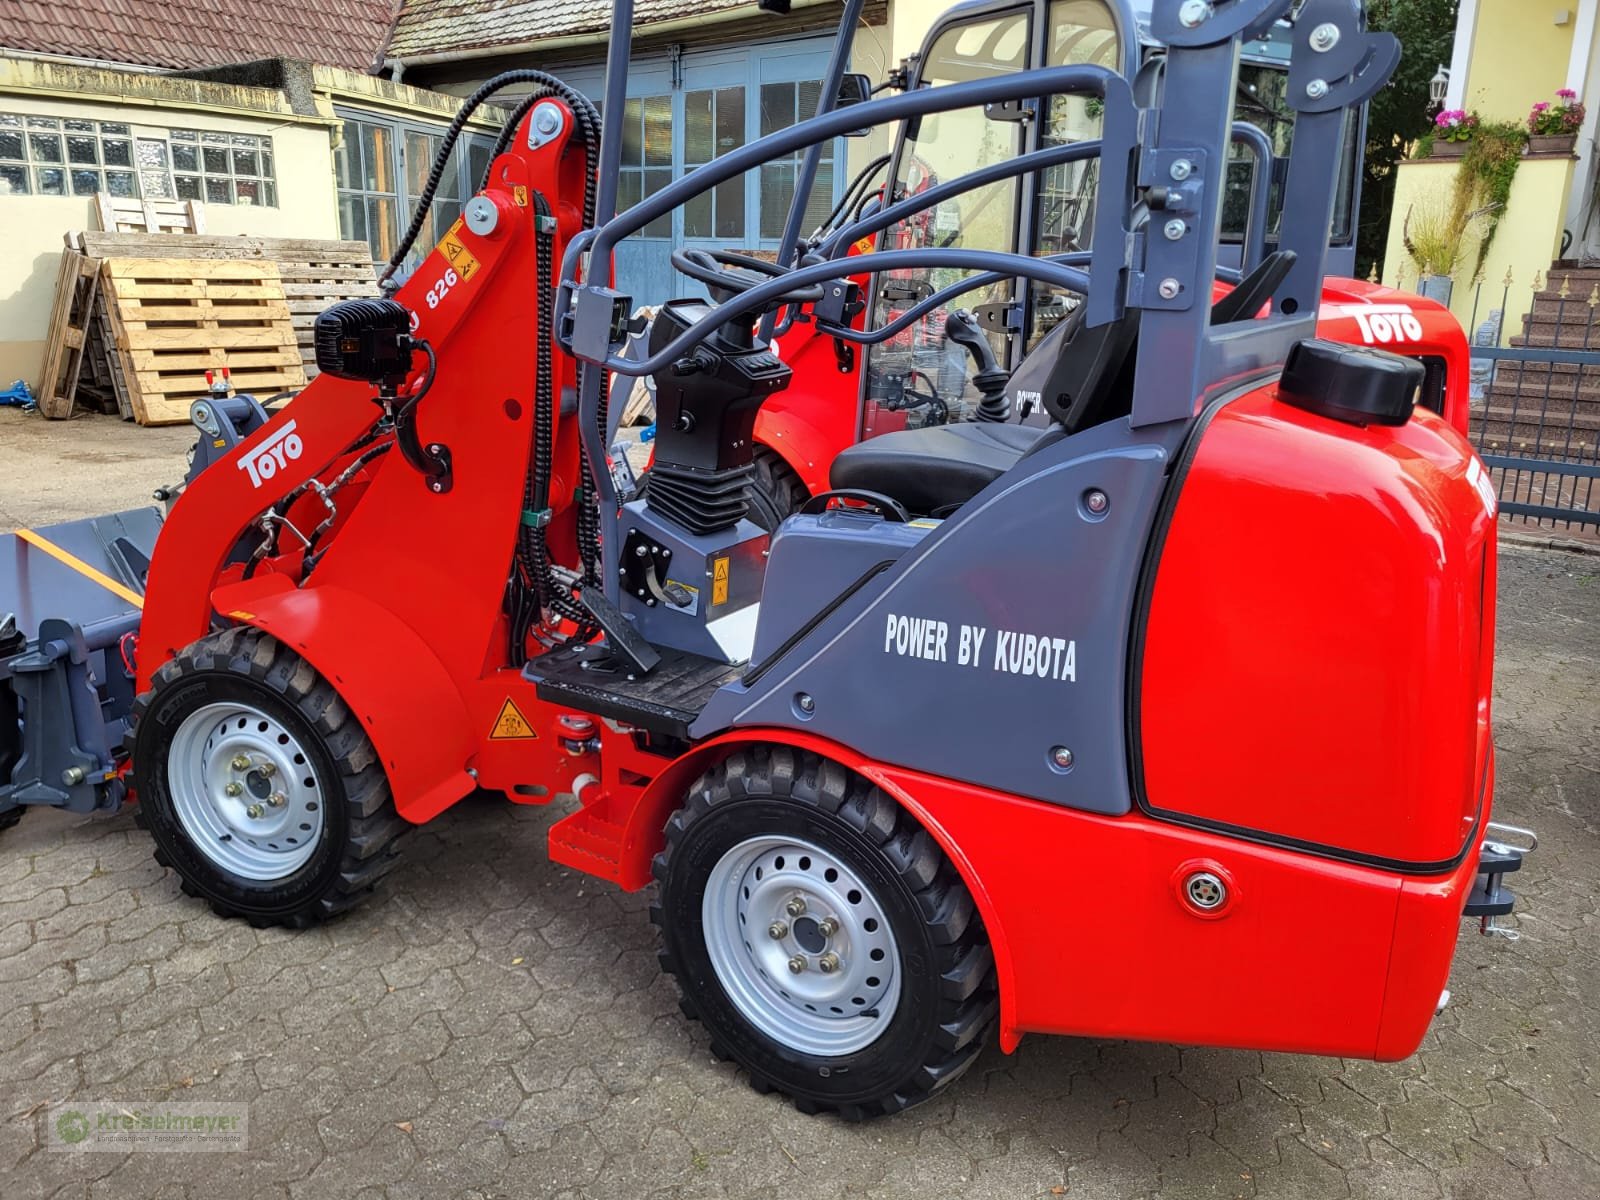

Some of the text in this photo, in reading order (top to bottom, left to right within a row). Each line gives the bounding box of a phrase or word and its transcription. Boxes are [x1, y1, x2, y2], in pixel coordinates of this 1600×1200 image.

[426, 268, 458, 309] 826
[1339, 303, 1423, 344] TOYO
[236, 418, 303, 489] TOYO
[885, 613, 1076, 682] POWER BY KUBOTA
